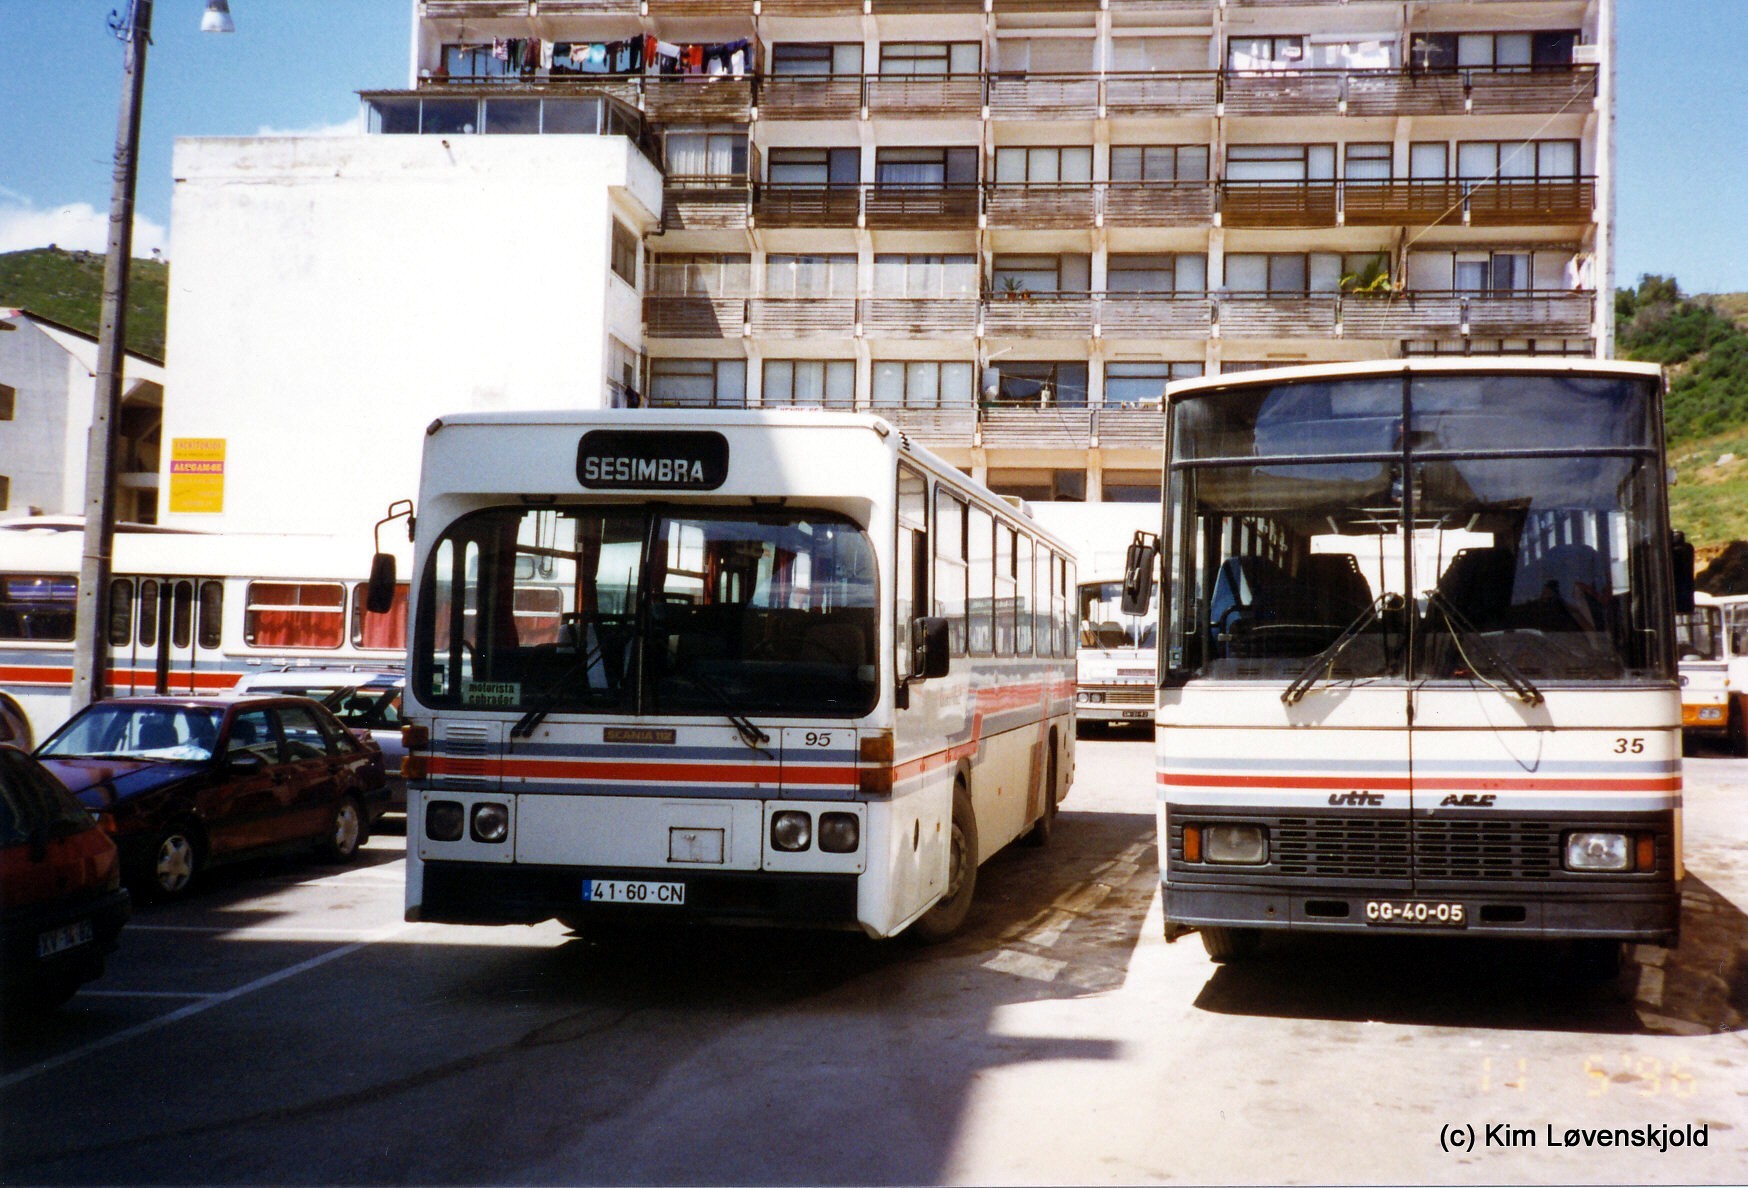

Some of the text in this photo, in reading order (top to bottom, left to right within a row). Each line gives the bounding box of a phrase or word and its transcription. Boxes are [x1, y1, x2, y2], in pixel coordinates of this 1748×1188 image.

[585, 456, 704, 482] SESIMBRA
[468, 683, 514, 693] motorista
[607, 730, 653, 740] SCANIA
[805, 732, 832, 747] 95
[1614, 738, 1645, 754] 35
[1366, 902, 1463, 921] CG-40-05
